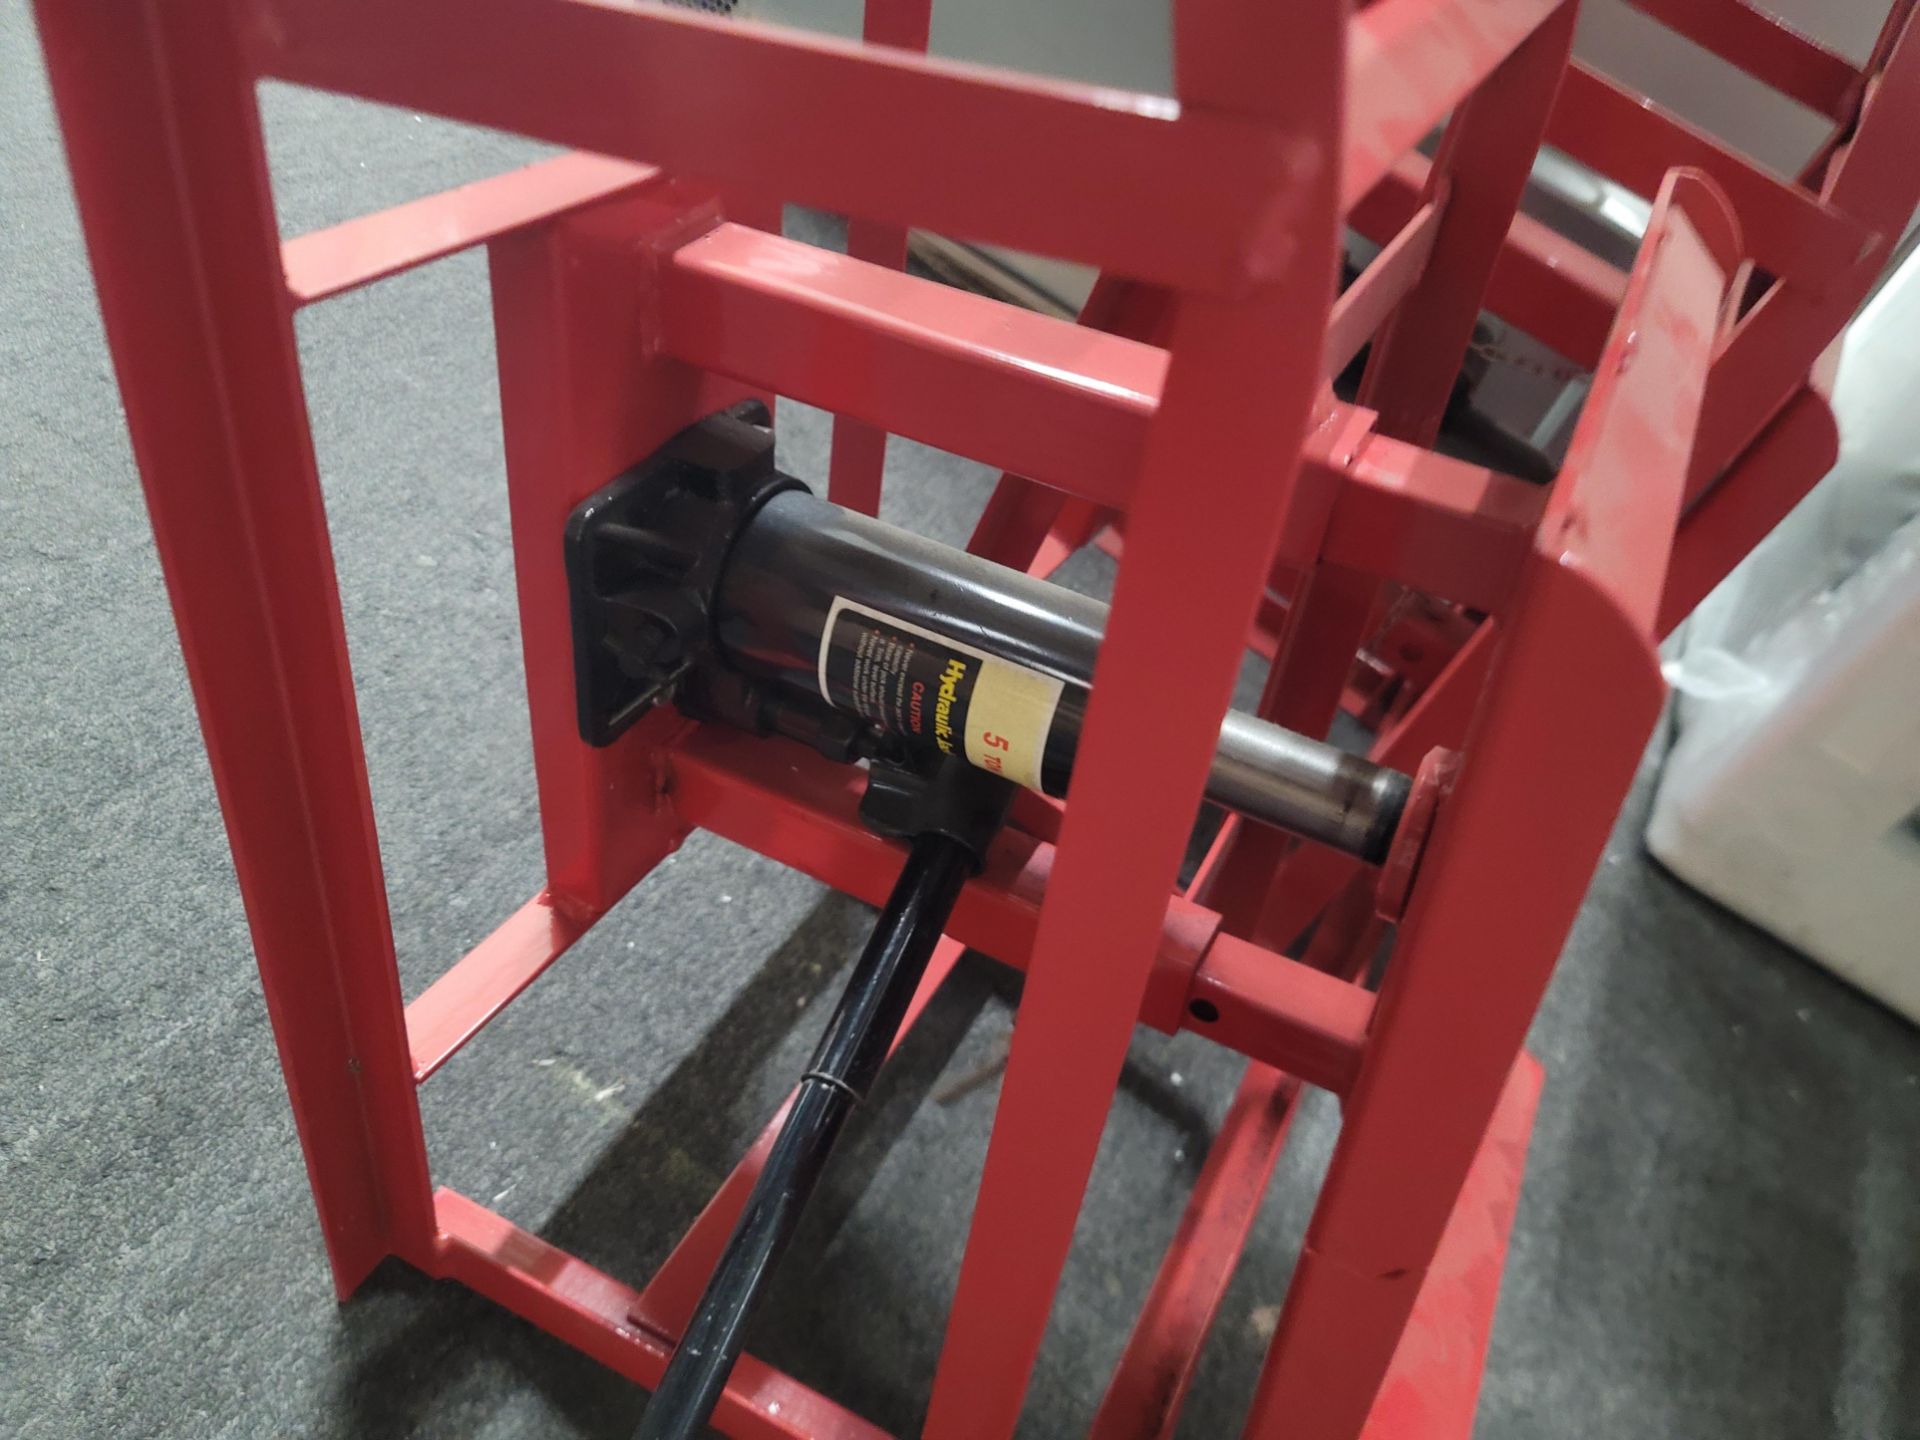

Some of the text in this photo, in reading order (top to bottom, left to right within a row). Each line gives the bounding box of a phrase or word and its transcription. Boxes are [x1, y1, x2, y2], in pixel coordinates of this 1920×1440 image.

[910, 682, 925, 734] CAUTION
[935, 659, 966, 738] Hydraulic
[983, 732, 1009, 752] 5
